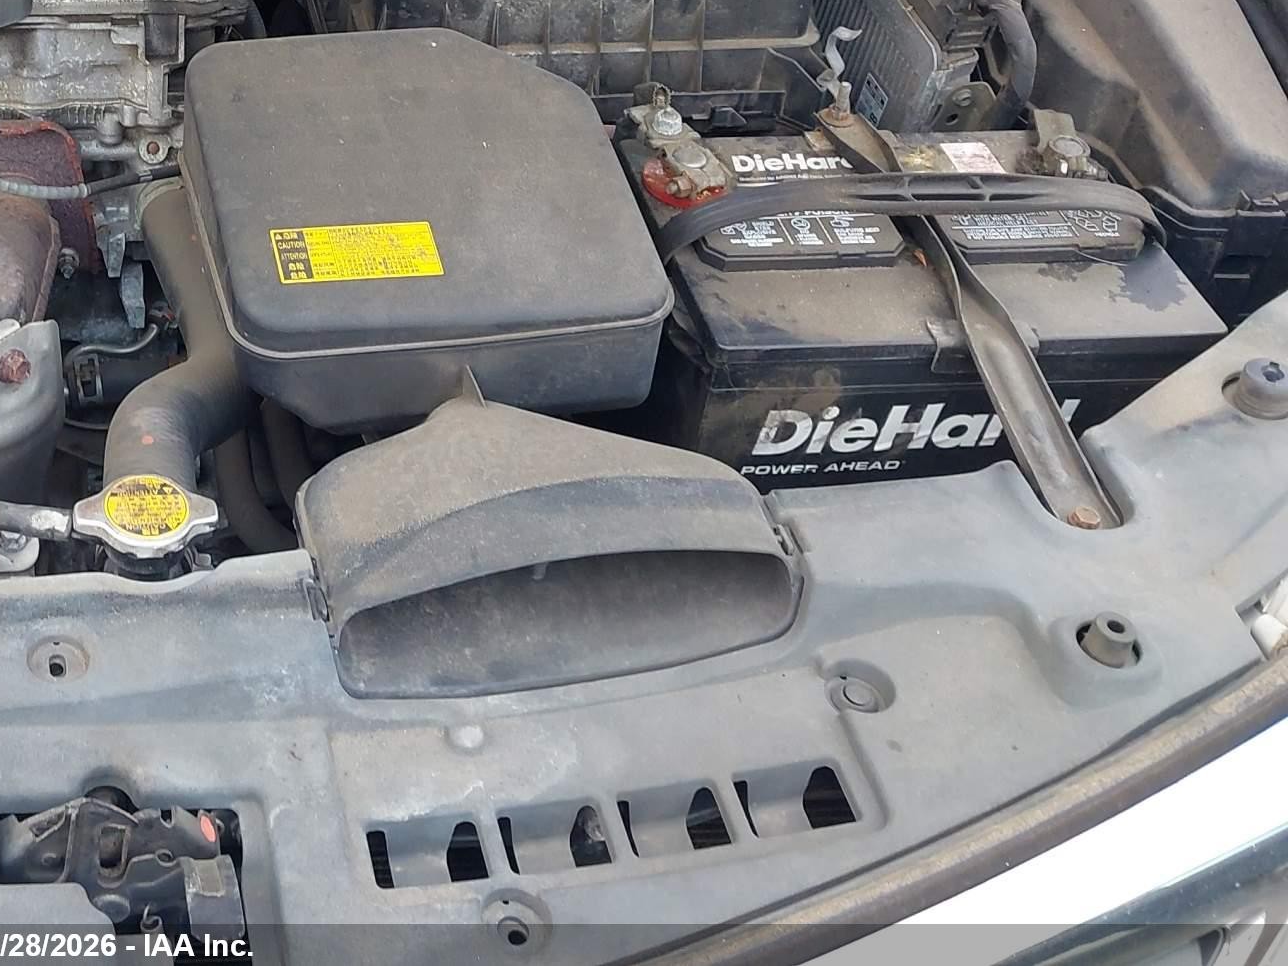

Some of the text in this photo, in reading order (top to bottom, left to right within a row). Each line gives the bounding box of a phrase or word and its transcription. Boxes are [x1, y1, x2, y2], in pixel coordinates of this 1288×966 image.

[277, 240, 305, 250] CAUTION
[752, 399, 1081, 455] DieHar
[824, 460, 901, 474] AHEAD
